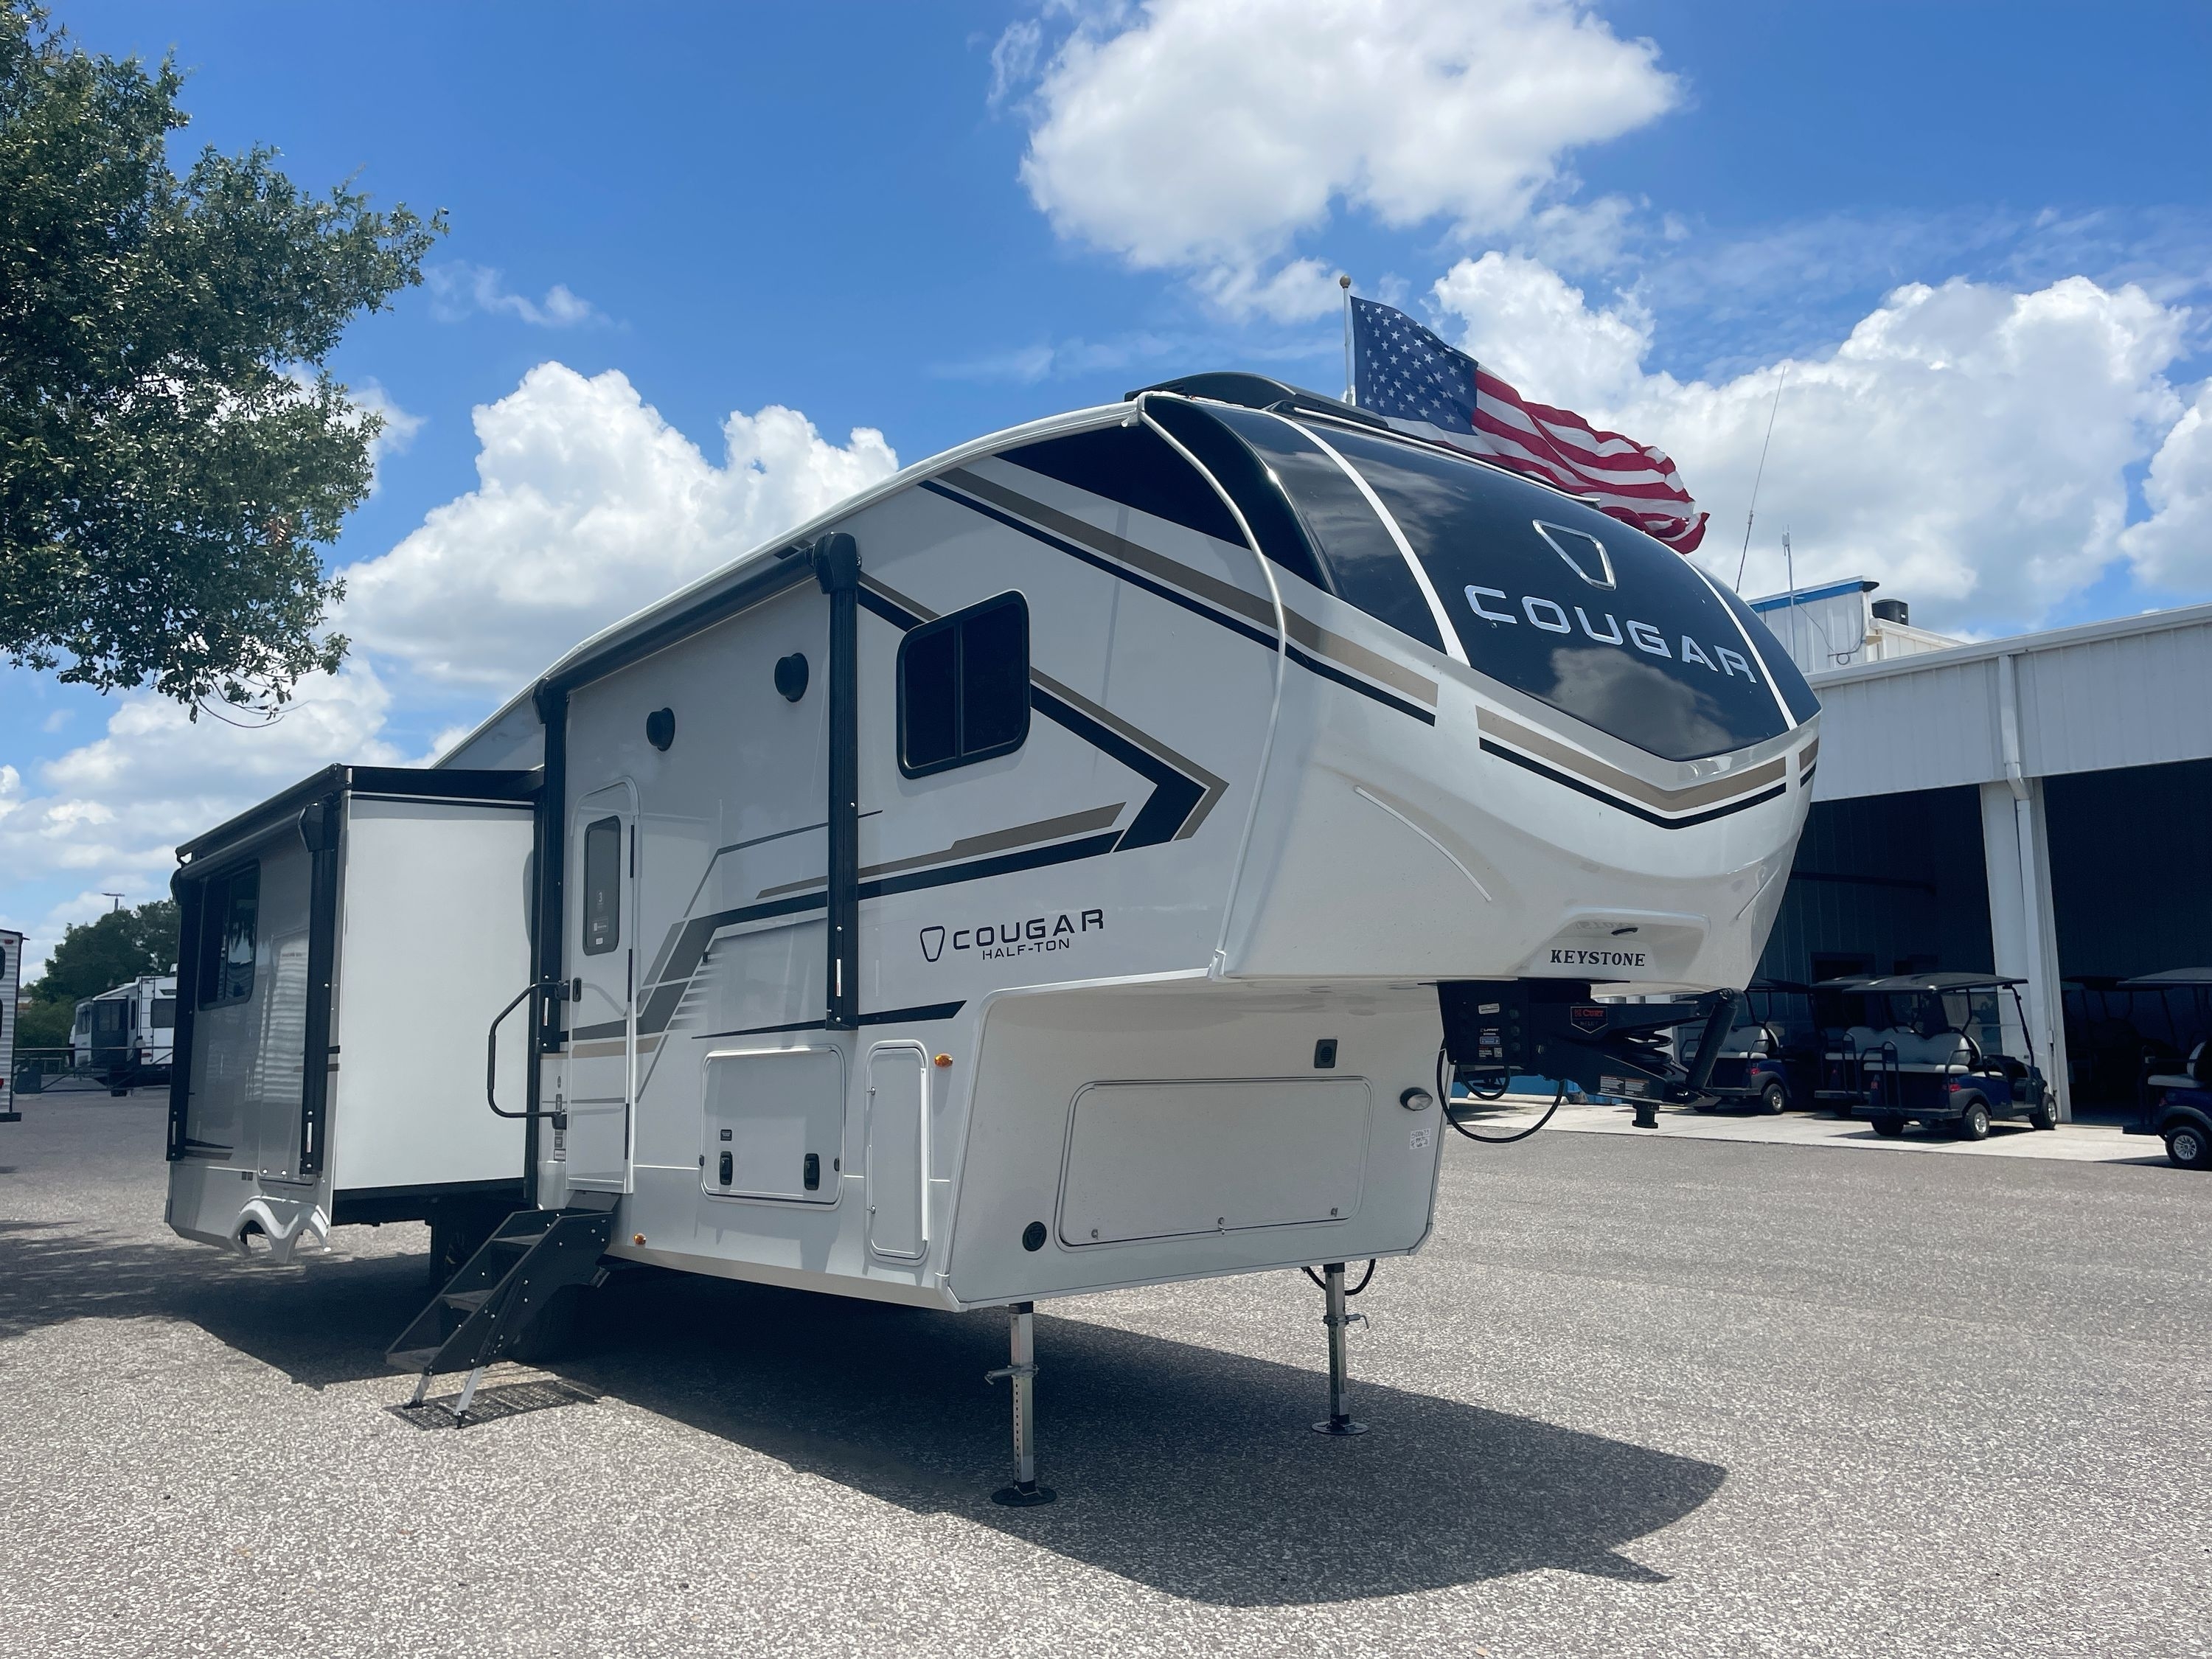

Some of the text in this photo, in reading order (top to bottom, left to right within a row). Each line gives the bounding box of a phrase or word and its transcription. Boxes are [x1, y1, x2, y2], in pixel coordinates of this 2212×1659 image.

[1464, 585, 1757, 684] COUGAR
[953, 908, 1104, 950] COUGAR
[982, 938, 1070, 960] HALF-TON
[1550, 949, 1646, 967] KEYSTONE
